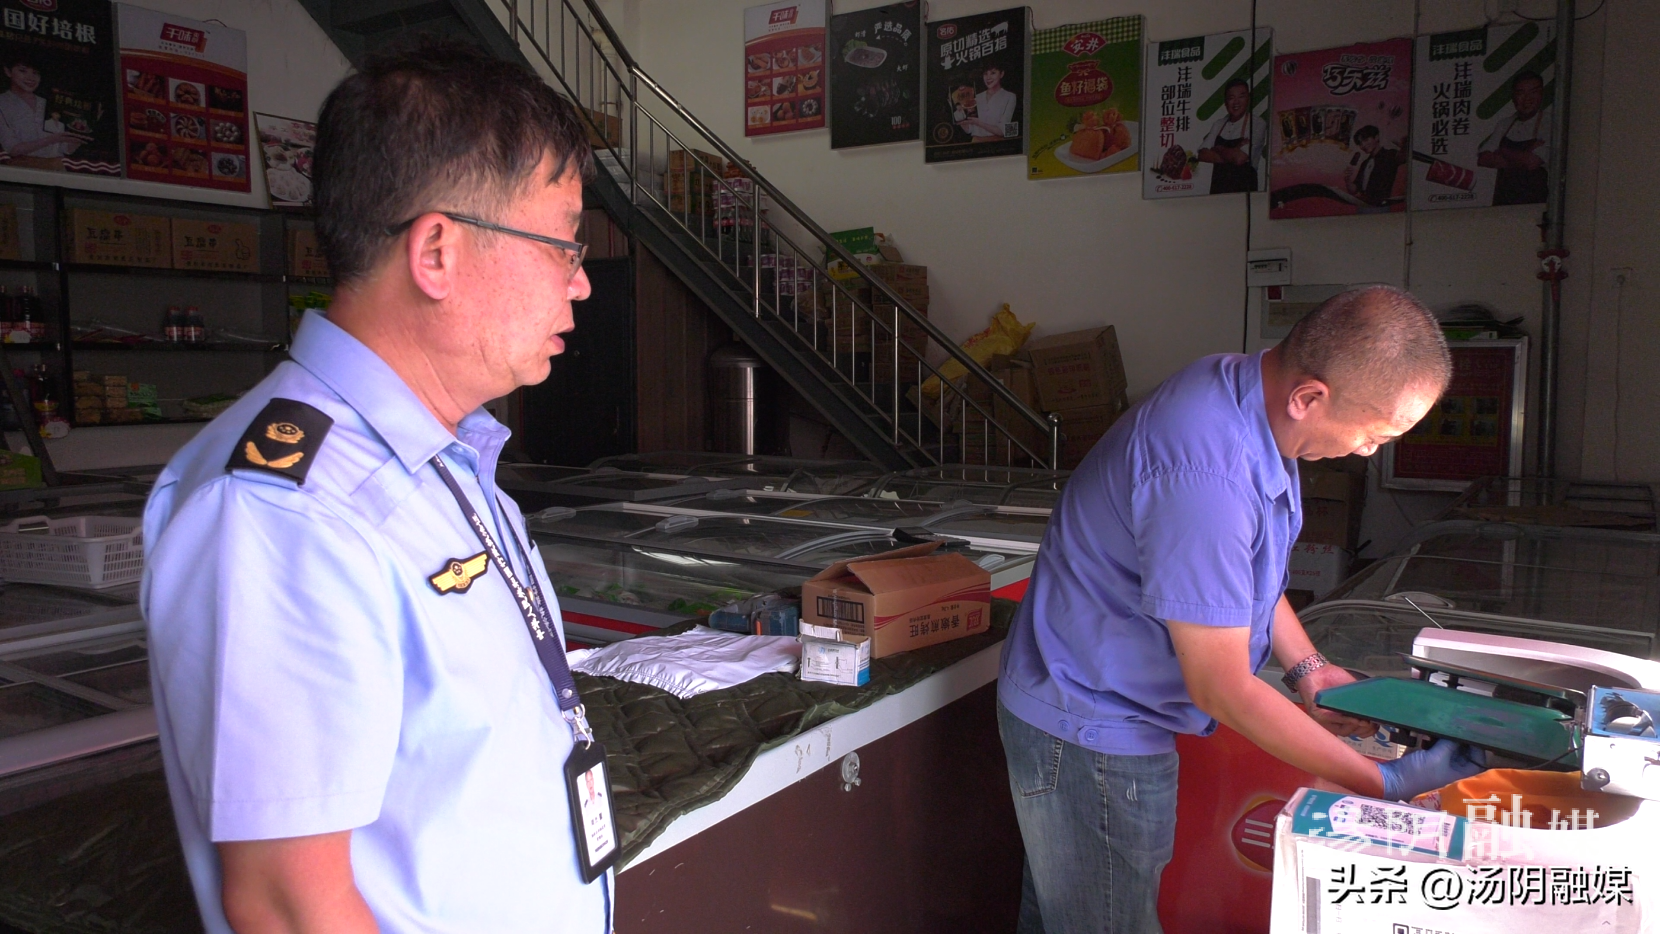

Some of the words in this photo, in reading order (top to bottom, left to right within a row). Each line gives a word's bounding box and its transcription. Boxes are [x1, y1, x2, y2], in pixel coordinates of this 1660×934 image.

[4, 8, 97, 44] 国好培根
[874, 20, 912, 41] 严选品质
[940, 27, 992, 58] 原切精选
[955, 35, 1007, 67] 火锅百搭
[1070, 37, 1100, 54] 安井
[1059, 76, 1109, 97] 鱼籽福袋
[1322, 62, 1391, 96] 巧乐兹
[1430, 82, 1451, 156] 火锅必选
